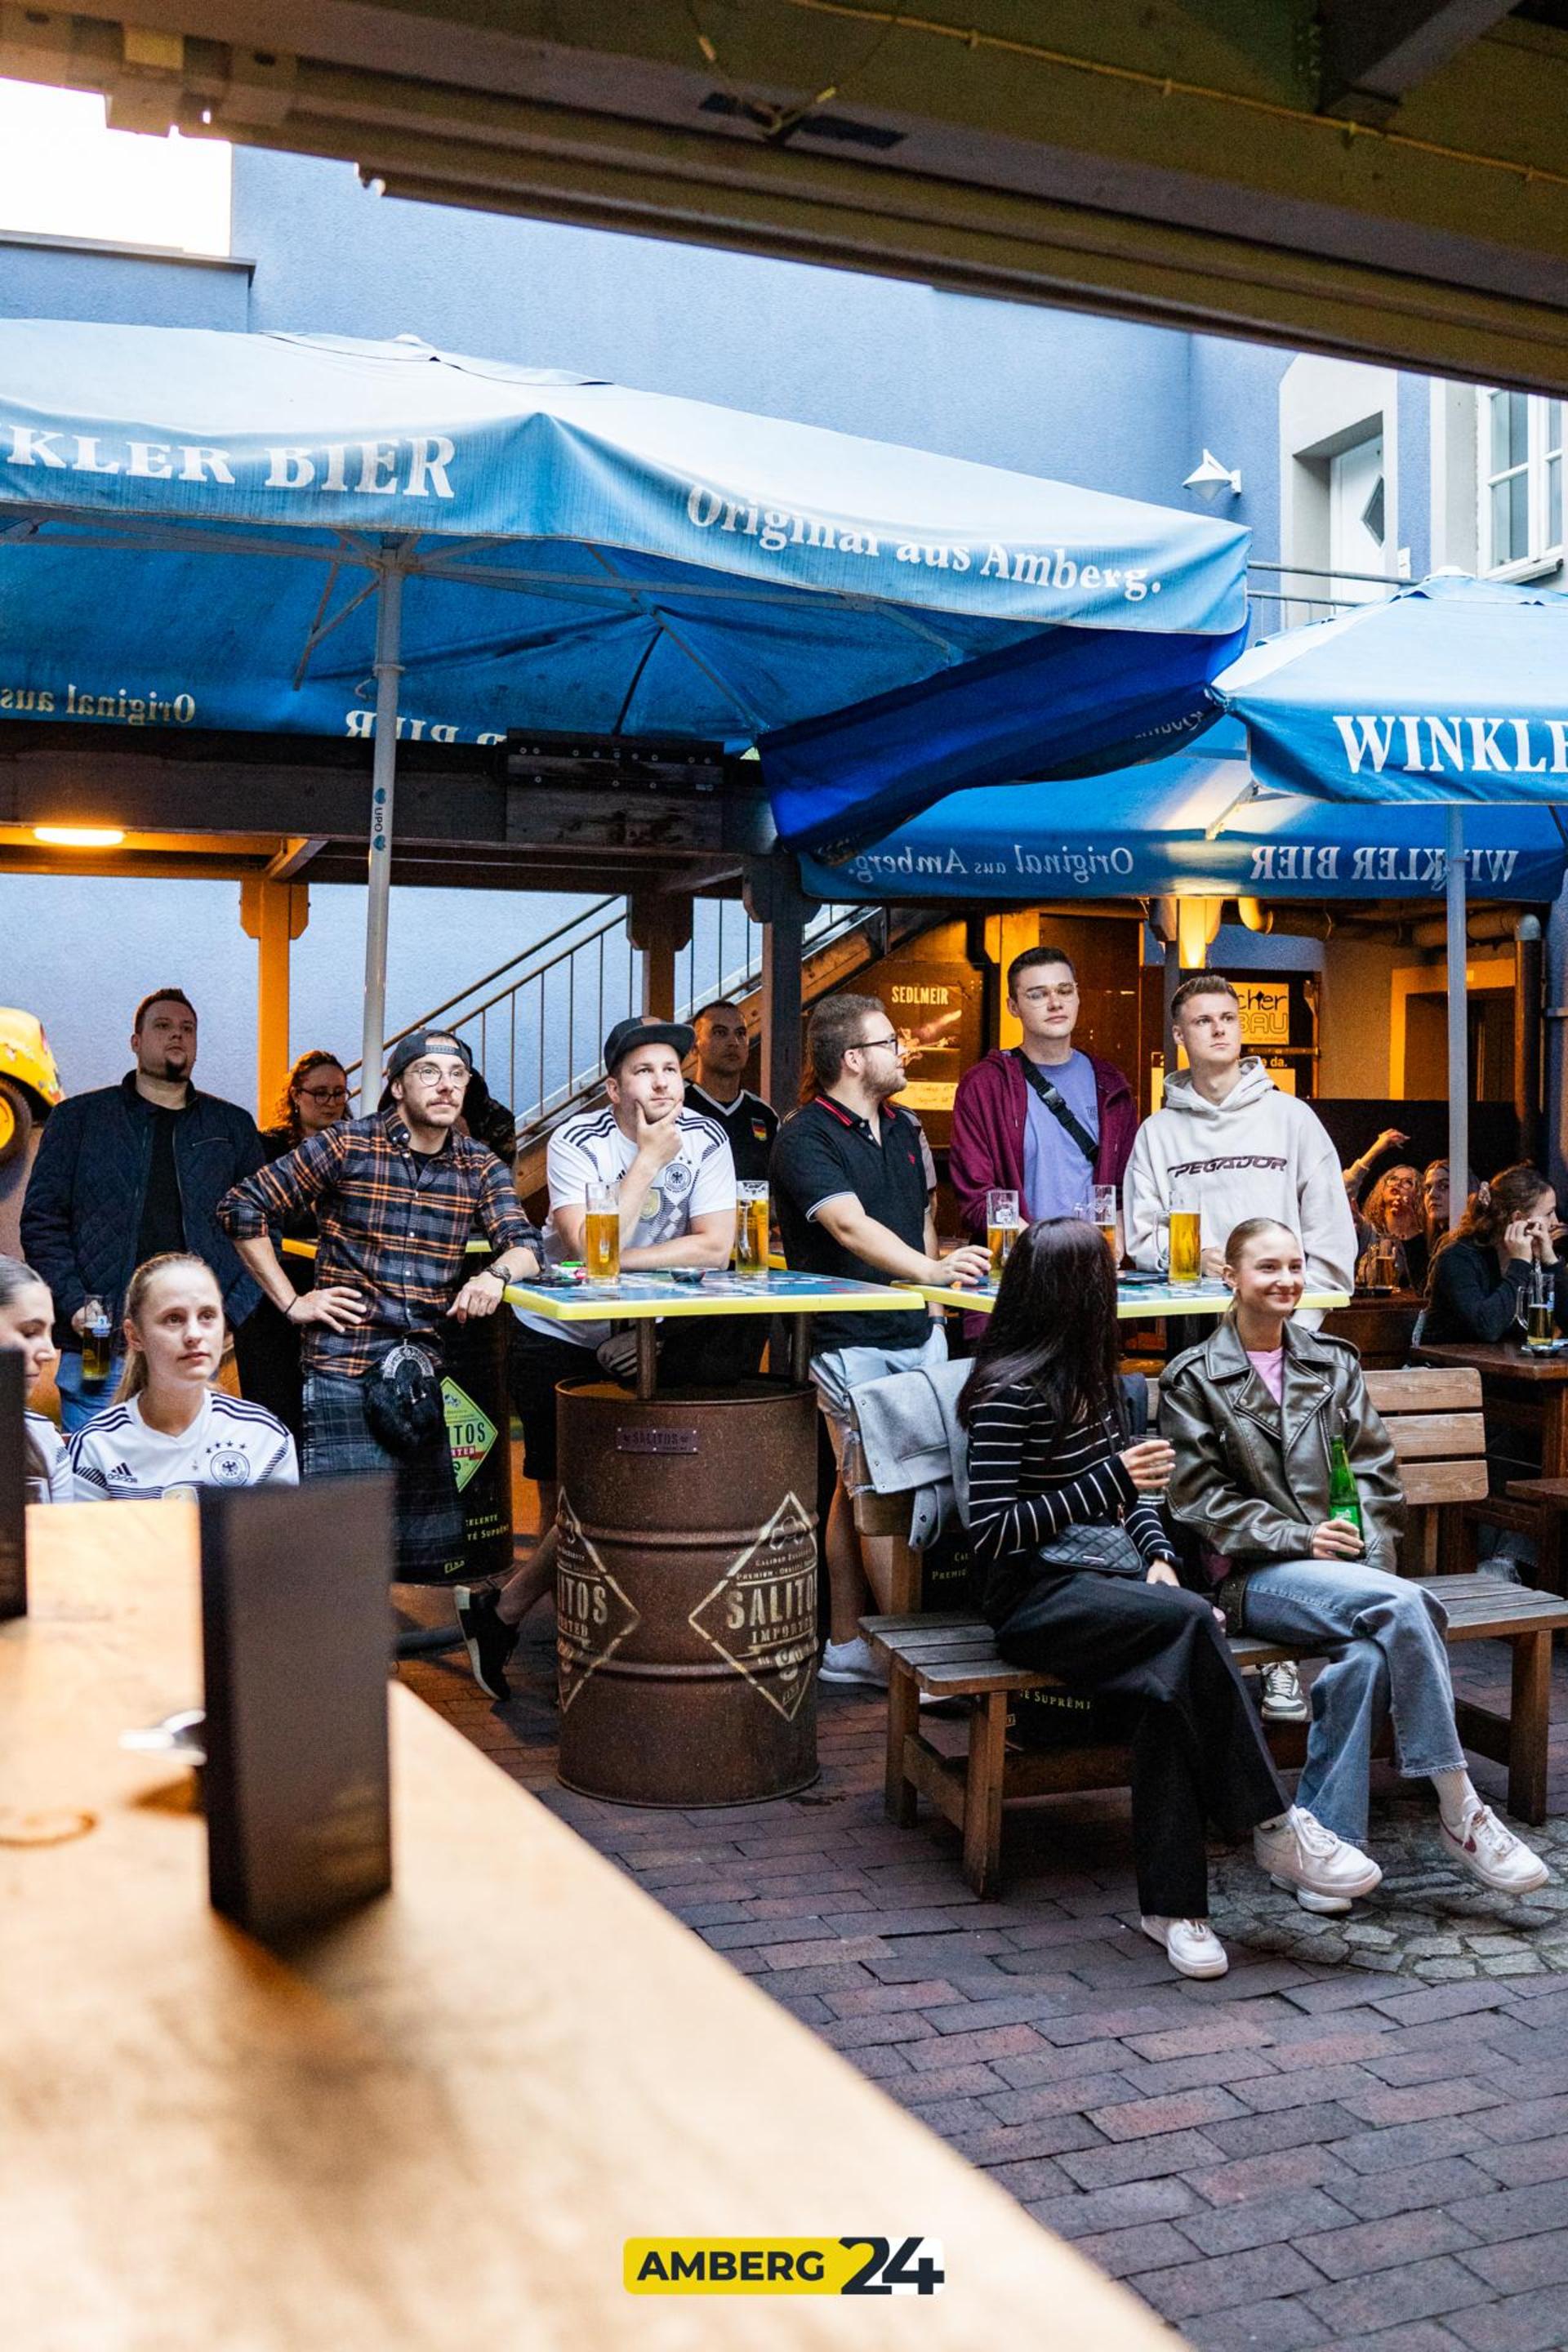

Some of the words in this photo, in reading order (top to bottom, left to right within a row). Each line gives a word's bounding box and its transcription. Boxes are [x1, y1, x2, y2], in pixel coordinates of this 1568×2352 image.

[265, 435, 456, 498] BIER
[896, 541, 971, 572] aus
[980, 543, 1160, 601] Amberg.
[892, 986, 948, 1005] SEDLMEIR
[1167, 1155, 1287, 1178] PEGADOR
